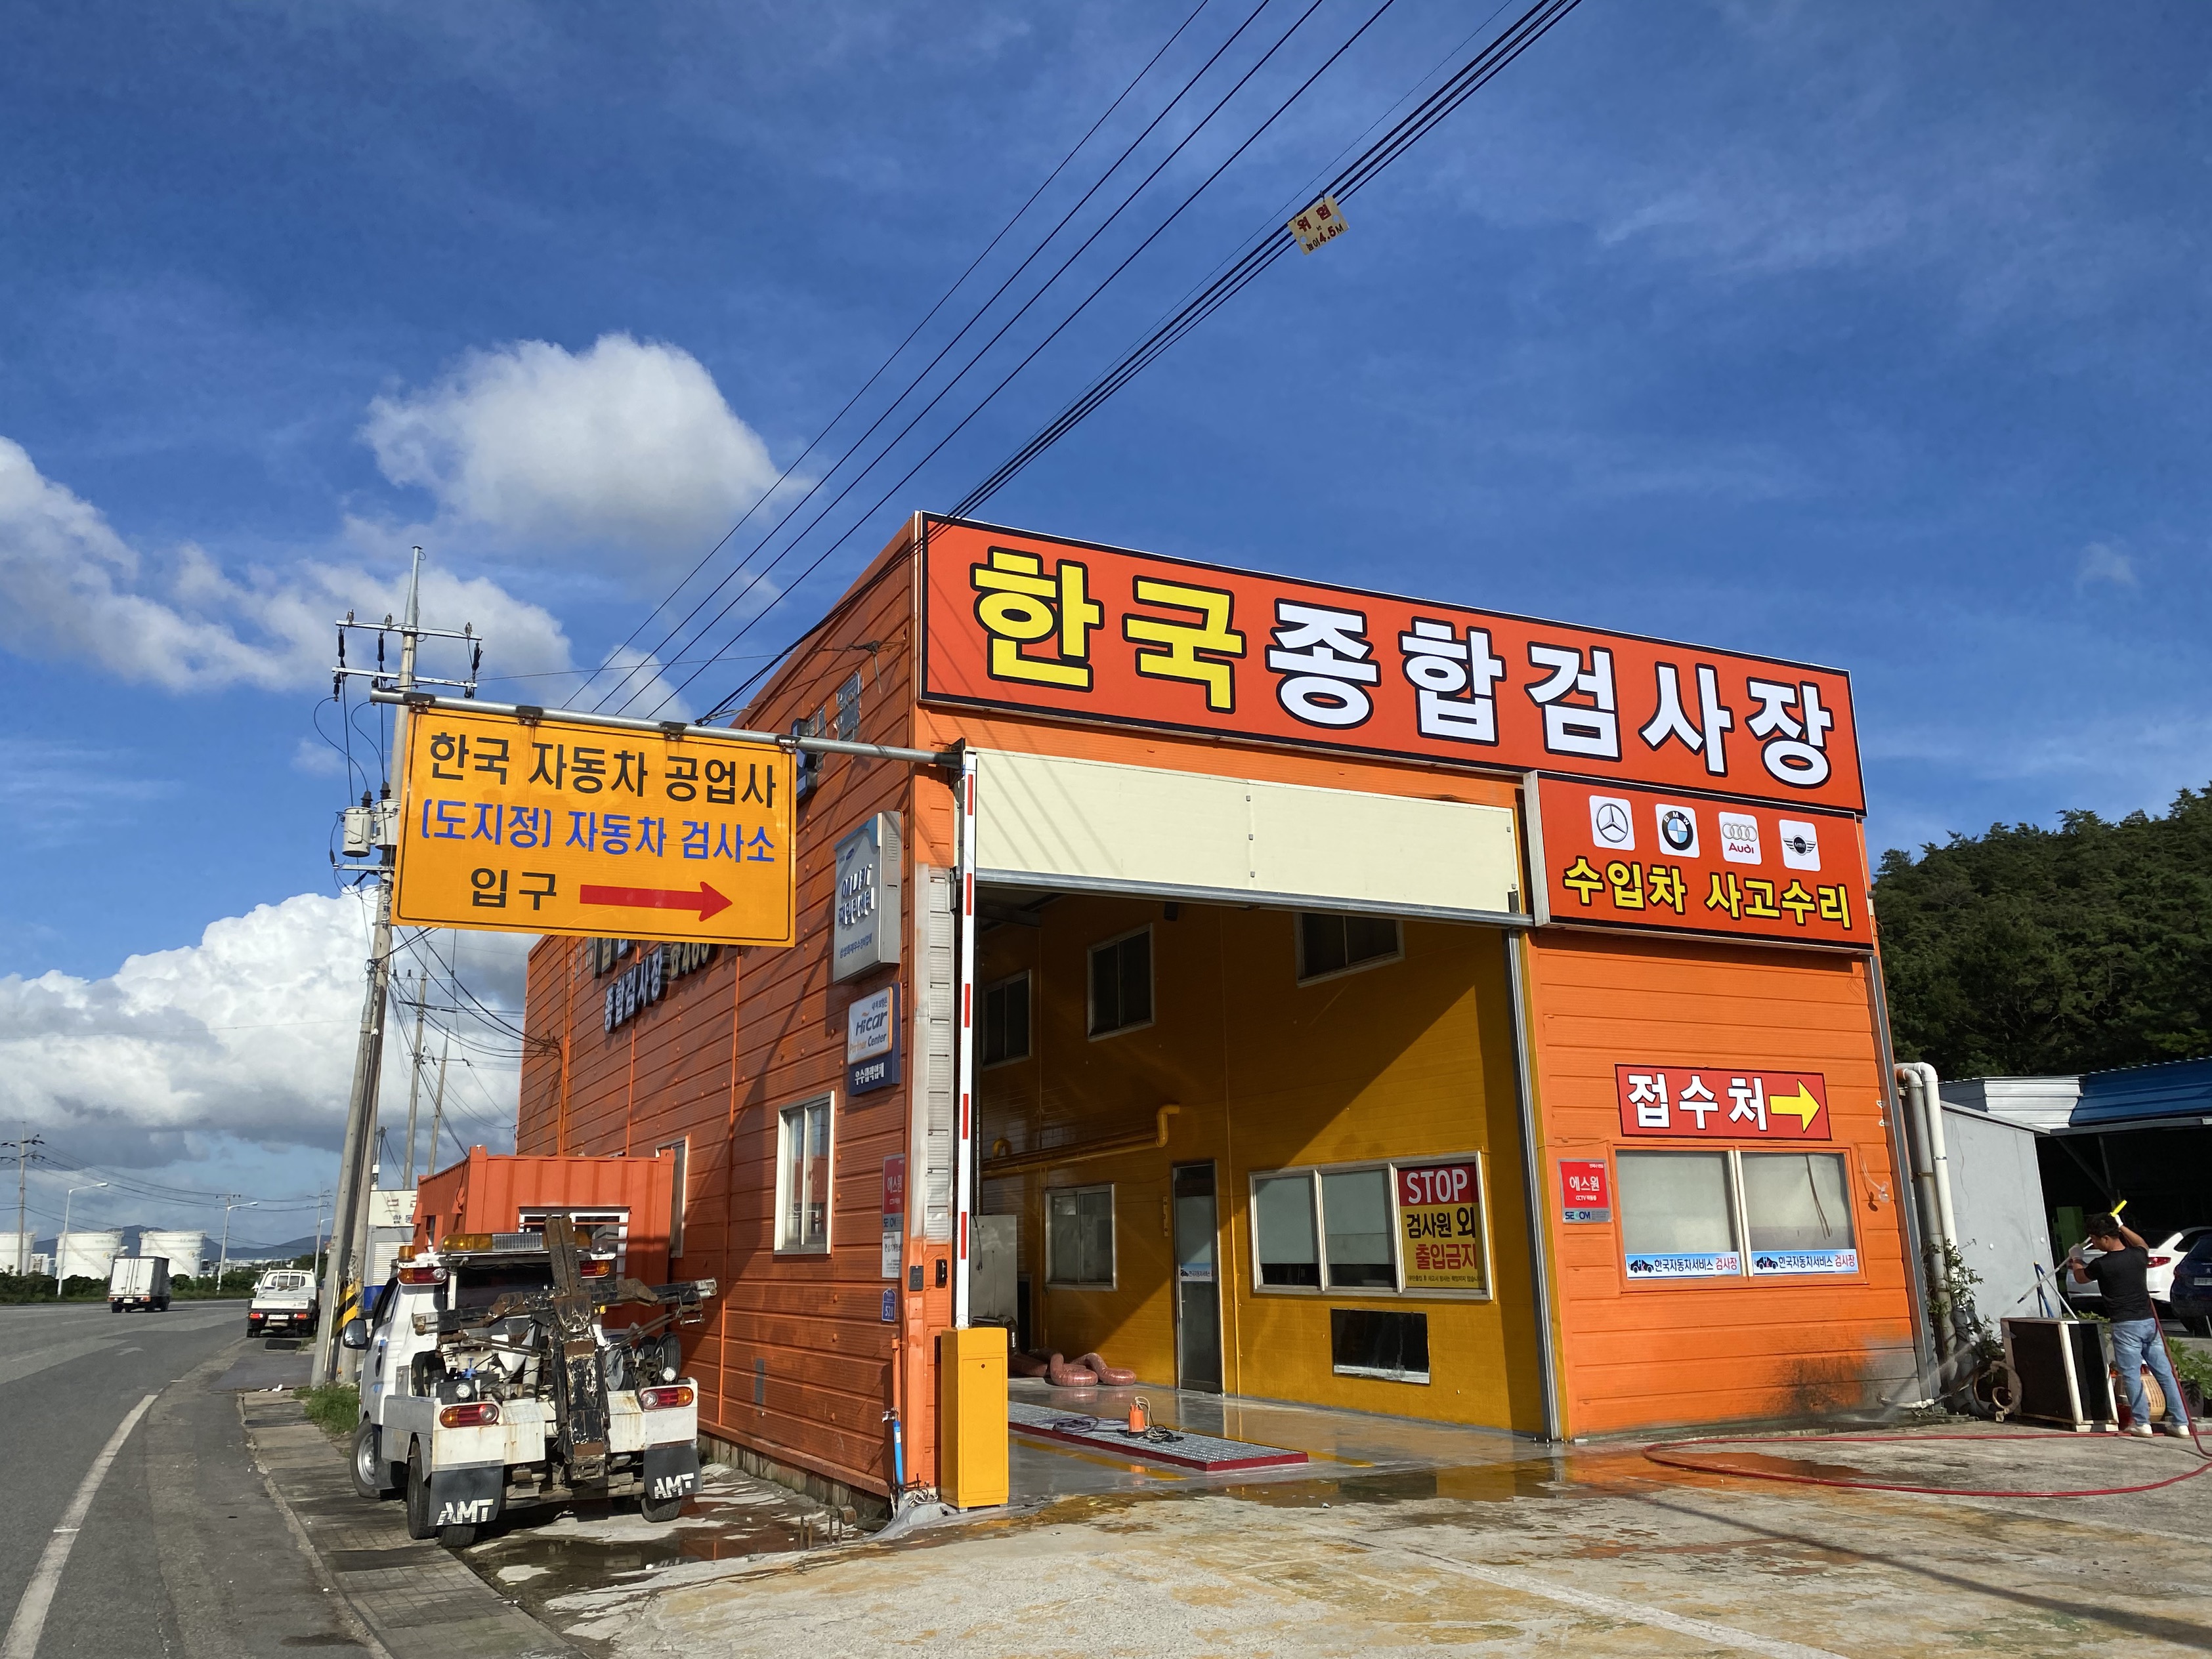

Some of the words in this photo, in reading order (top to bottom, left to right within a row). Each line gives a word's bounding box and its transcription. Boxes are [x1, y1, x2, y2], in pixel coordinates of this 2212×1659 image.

[1297, 204, 1332, 232] 위험
[430, 732, 509, 785] 한국
[528, 742, 648, 797] 자동차
[664, 755, 776, 808] 공업사
[566, 810, 667, 857] 자동차
[681, 820, 775, 863] 검사소
[1728, 842, 1755, 854] Audi
[470, 868, 557, 911] 입구
[1563, 856, 1687, 915] 수입차
[1705, 872, 1852, 931] 사고수리
[856, 1011, 887, 1036] Hicar
[868, 1033, 887, 1047] Center
[1627, 1073, 1768, 1131] 접수처
[887, 1175, 902, 1193] 에스원
[1407, 1169, 1468, 1204] STOP
[1569, 1176, 1600, 1191] 에스원
[1407, 1212, 1452, 1238] 검사원
[1457, 1208, 1476, 1238] 외
[1416, 1244, 1477, 1270] 출입금지
[1654, 1258, 1713, 1272] 한국자동차서비스
[1716, 1257, 1737, 1270] 검사장
[1778, 1255, 1833, 1269] 한국자동차서비스
[1835, 1254, 1855, 1267] 검사장
[654, 1473, 694, 1499] AMT
[436, 1499, 494, 1525] AMT
